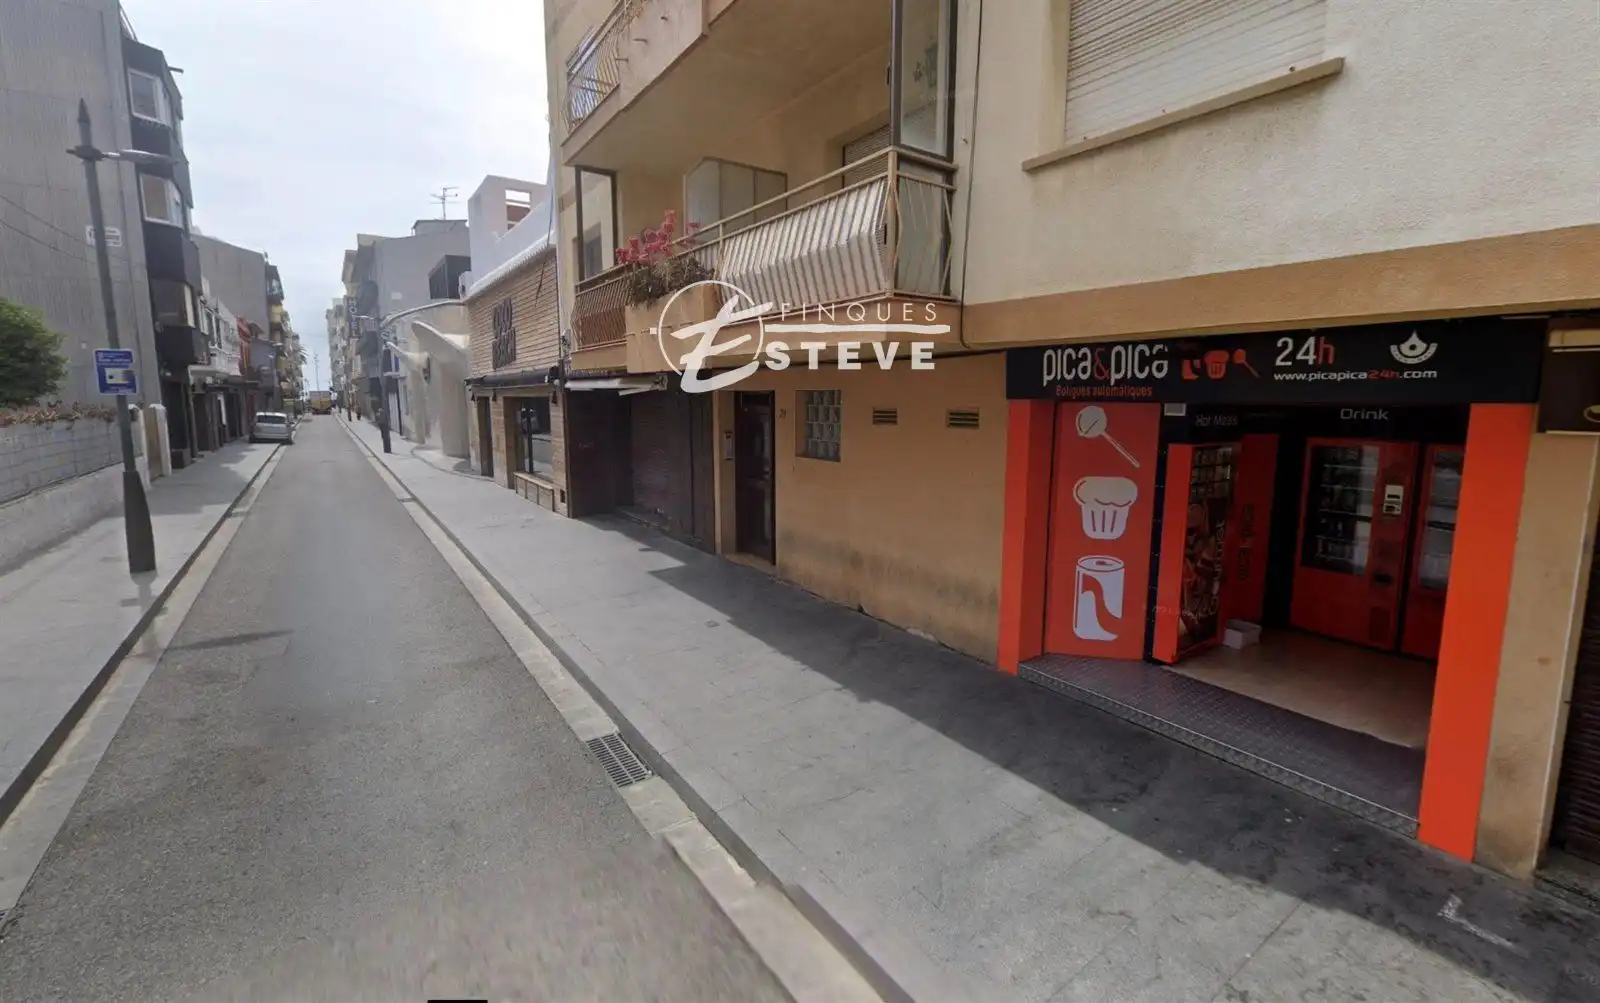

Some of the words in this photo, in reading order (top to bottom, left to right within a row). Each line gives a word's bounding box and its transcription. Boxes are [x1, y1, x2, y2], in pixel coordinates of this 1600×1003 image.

[1275, 335, 1335, 367] 24h
[1042, 343, 1169, 388] pica&pica
[1273, 368, 1438, 382] www.picapica24h.com
[1339, 407, 1389, 421] Drink
